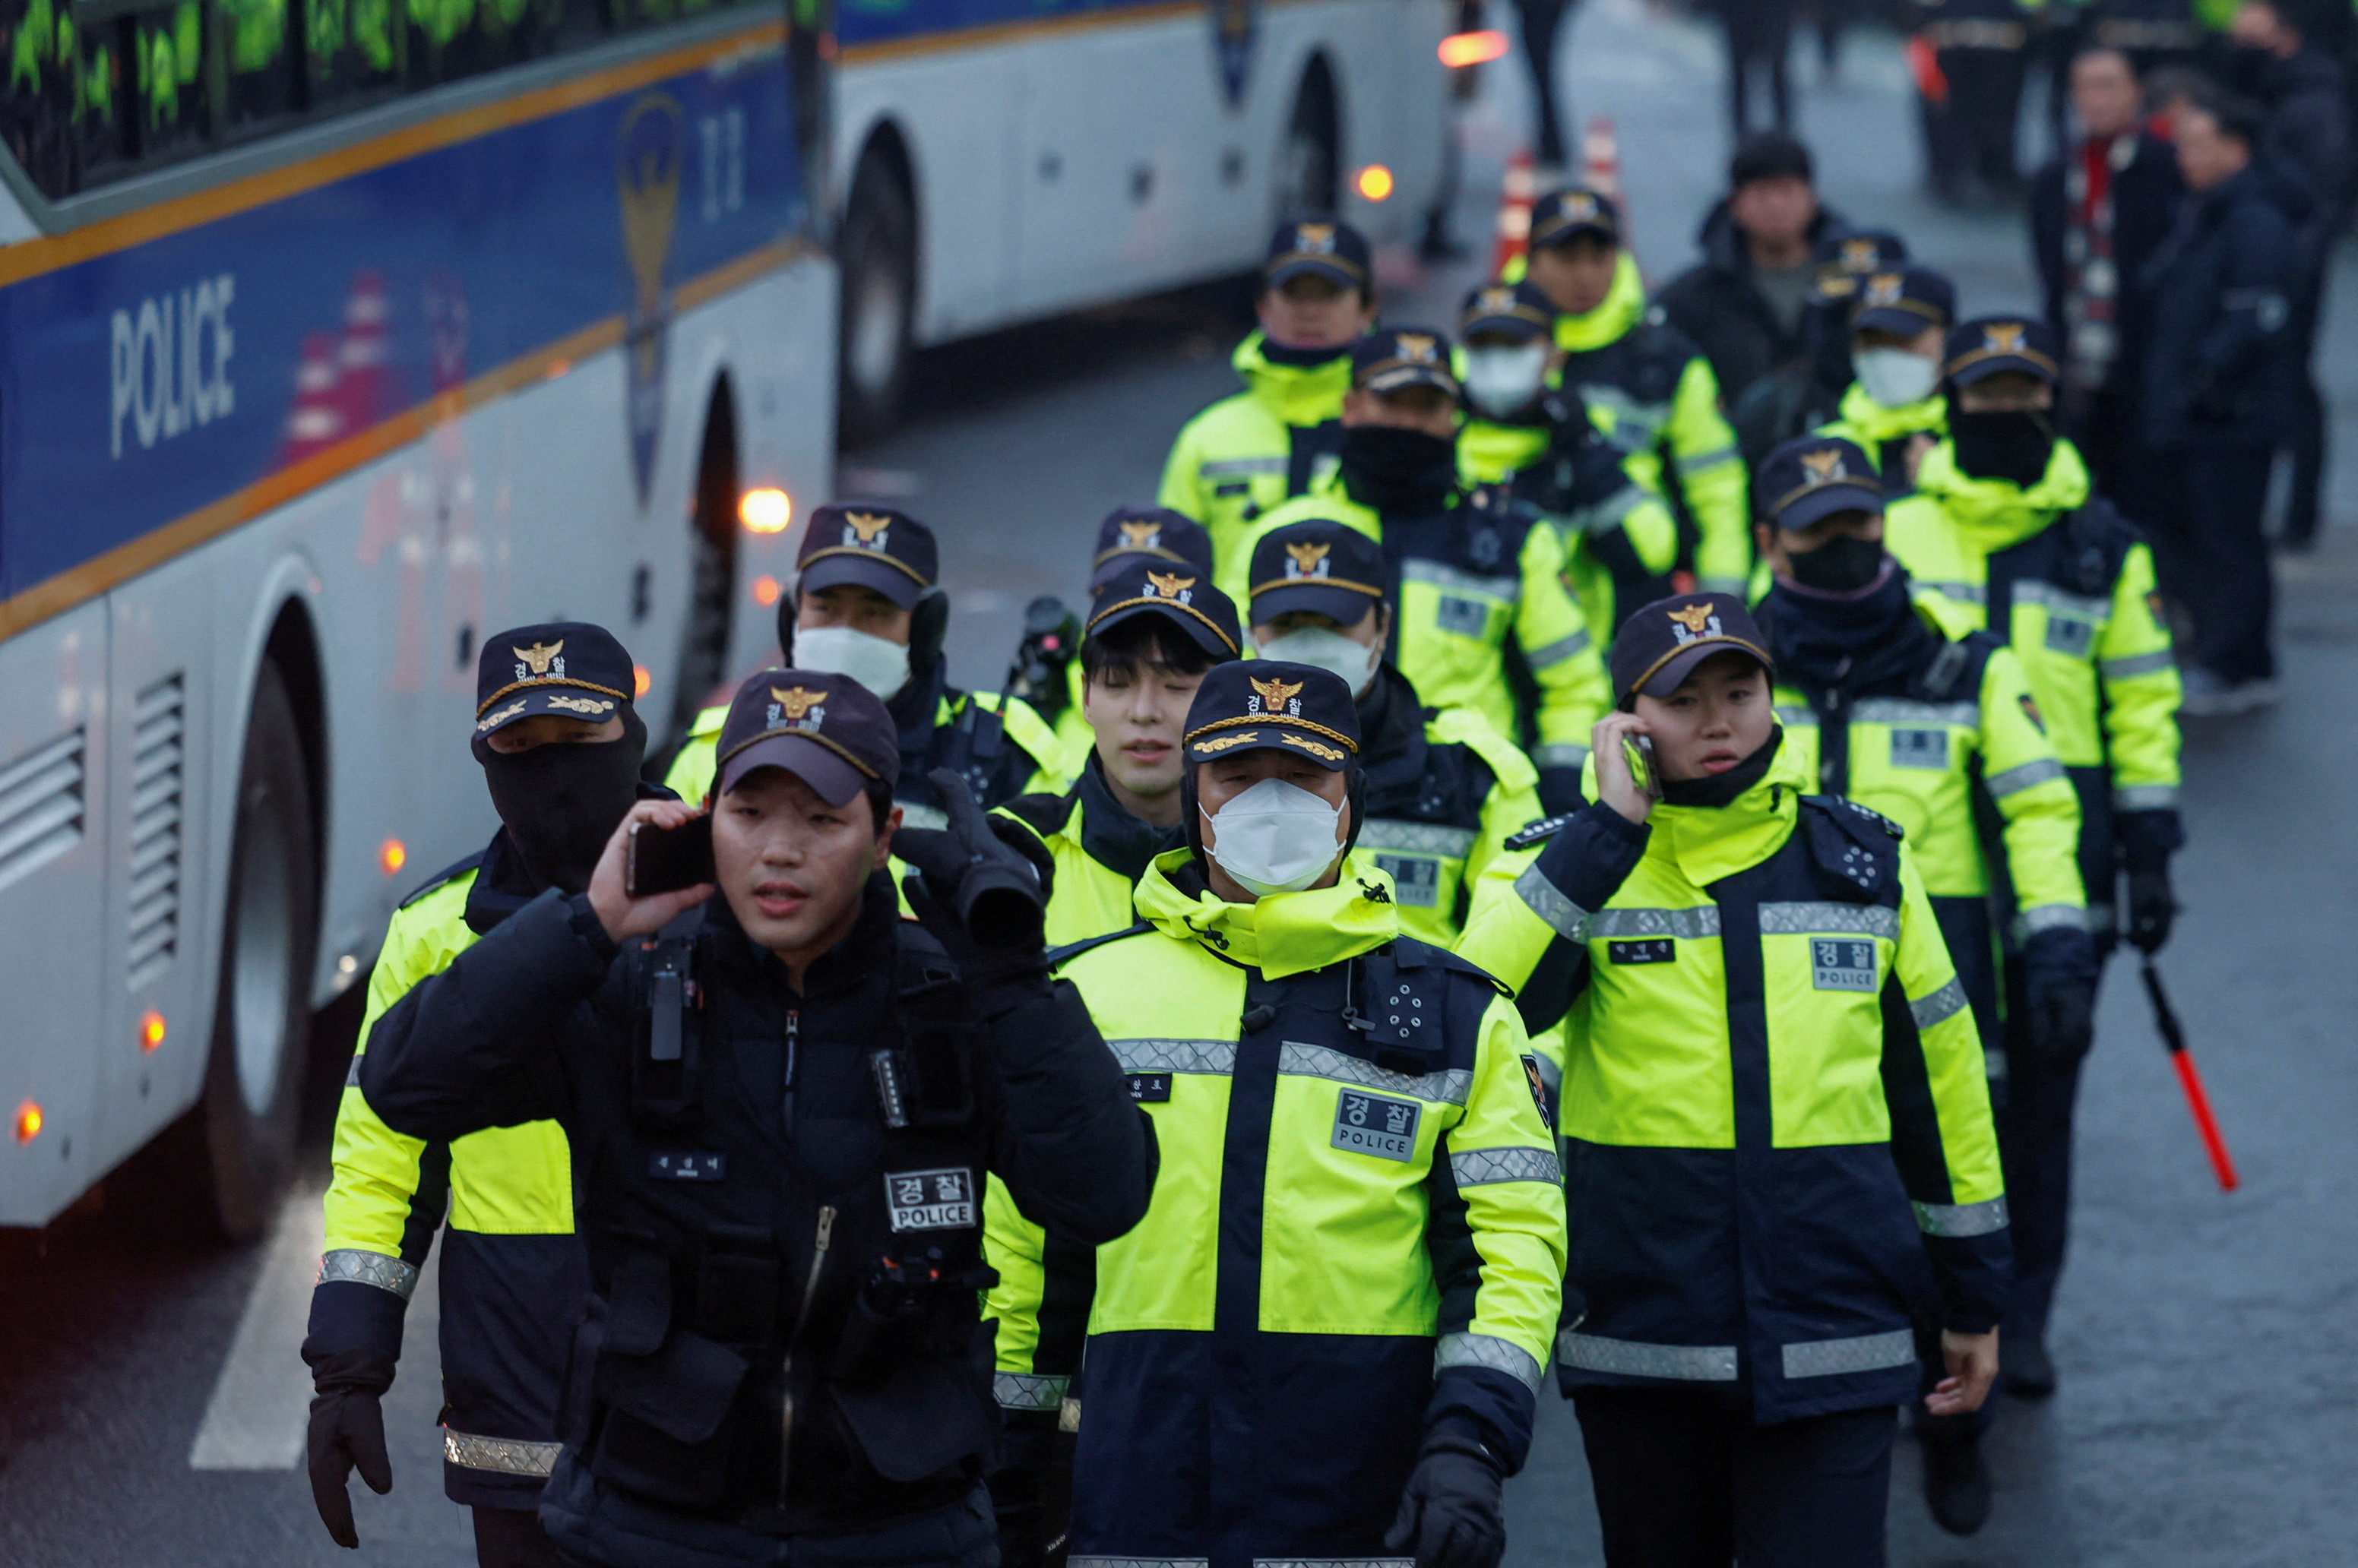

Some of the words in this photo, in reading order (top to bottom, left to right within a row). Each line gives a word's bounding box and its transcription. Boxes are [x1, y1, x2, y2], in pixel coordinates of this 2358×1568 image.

[111, 275, 235, 460] POLICE
[1820, 972, 1871, 985] POLICE
[1340, 1129, 1406, 1153] POLICE
[898, 1206, 968, 1225] POLICE
